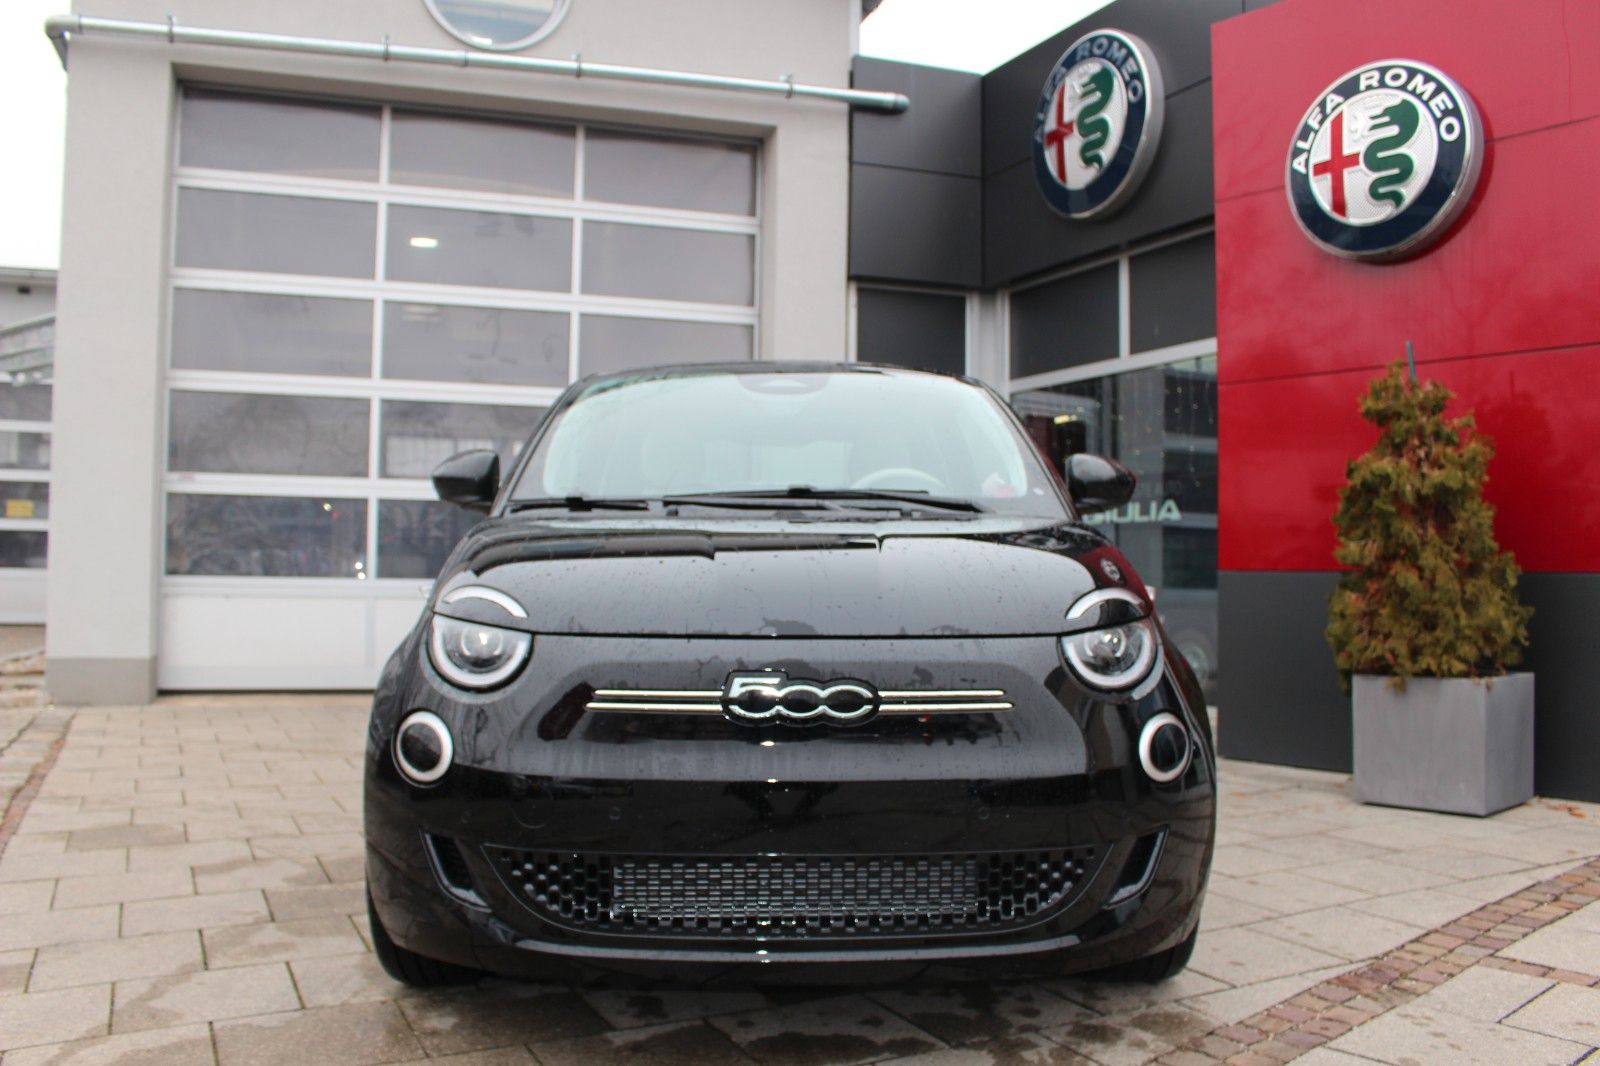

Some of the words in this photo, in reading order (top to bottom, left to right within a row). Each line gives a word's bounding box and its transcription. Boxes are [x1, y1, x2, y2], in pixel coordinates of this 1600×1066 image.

[1075, 36, 1143, 104] ROMEO
[1292, 92, 1345, 175] ALFA
[1358, 67, 1461, 142] ROMEO
[727, 676, 874, 718] 500
